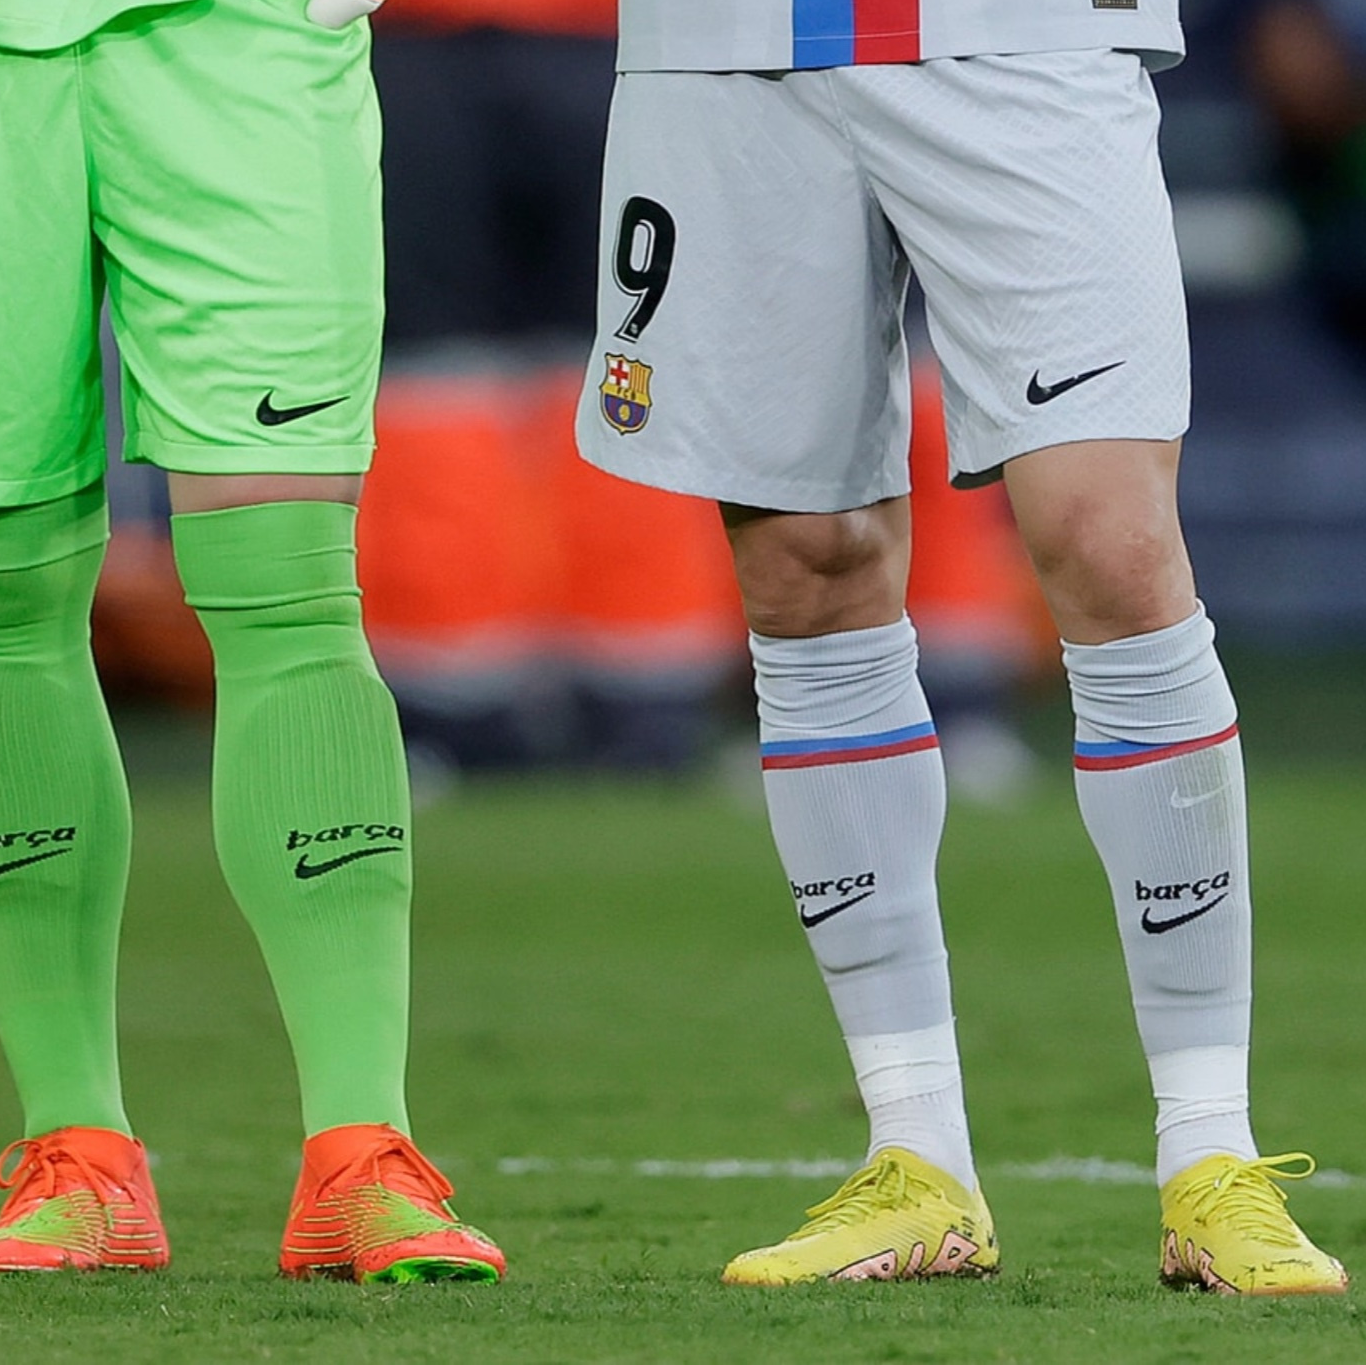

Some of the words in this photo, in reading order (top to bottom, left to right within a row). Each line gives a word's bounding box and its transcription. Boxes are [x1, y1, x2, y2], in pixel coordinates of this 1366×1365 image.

[612, 195, 677, 344] 9
[285, 822, 406, 852] barça
[790, 870, 876, 900] barça
[1135, 870, 1231, 902] barça
